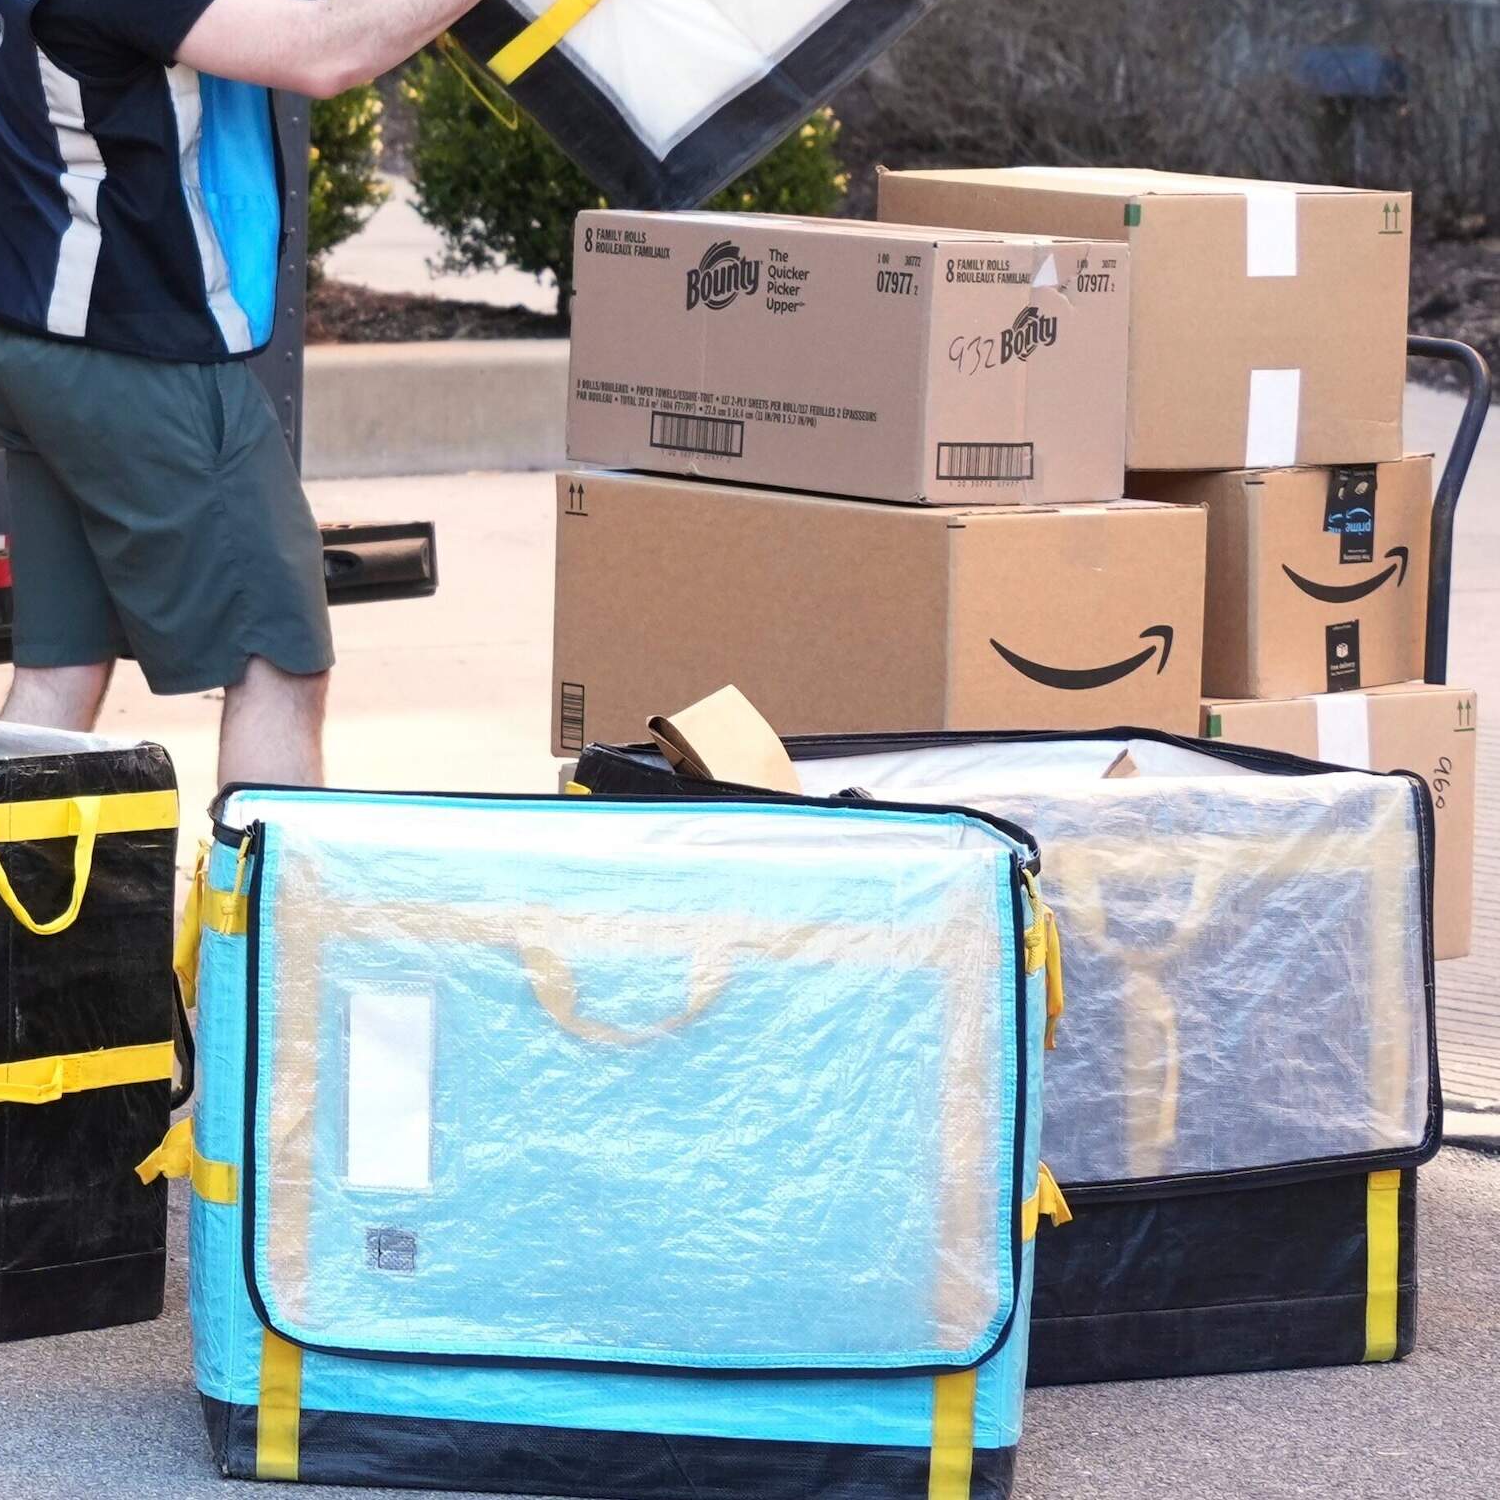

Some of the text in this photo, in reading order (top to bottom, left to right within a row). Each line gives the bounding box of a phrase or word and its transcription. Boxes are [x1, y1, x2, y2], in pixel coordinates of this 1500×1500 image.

[584, 228, 647, 253] 8 FAMILY ROLLS
[595, 242, 671, 260] ROULEAUX FAMILIAUX
[768, 248, 789, 263] The
[767, 265, 810, 281] Quicker
[946, 259, 1010, 283] 8 FAMILY ROLLS
[956, 272, 1032, 285] ROULEAUX FAMILIAU
[686, 255, 761, 311] Bounty
[766, 281, 800, 297] Picker
[876, 270, 913, 295] 07977
[1077, 273, 1110, 293] 07977
[765, 297, 797, 315] Upper
[948, 336, 997, 376] 932
